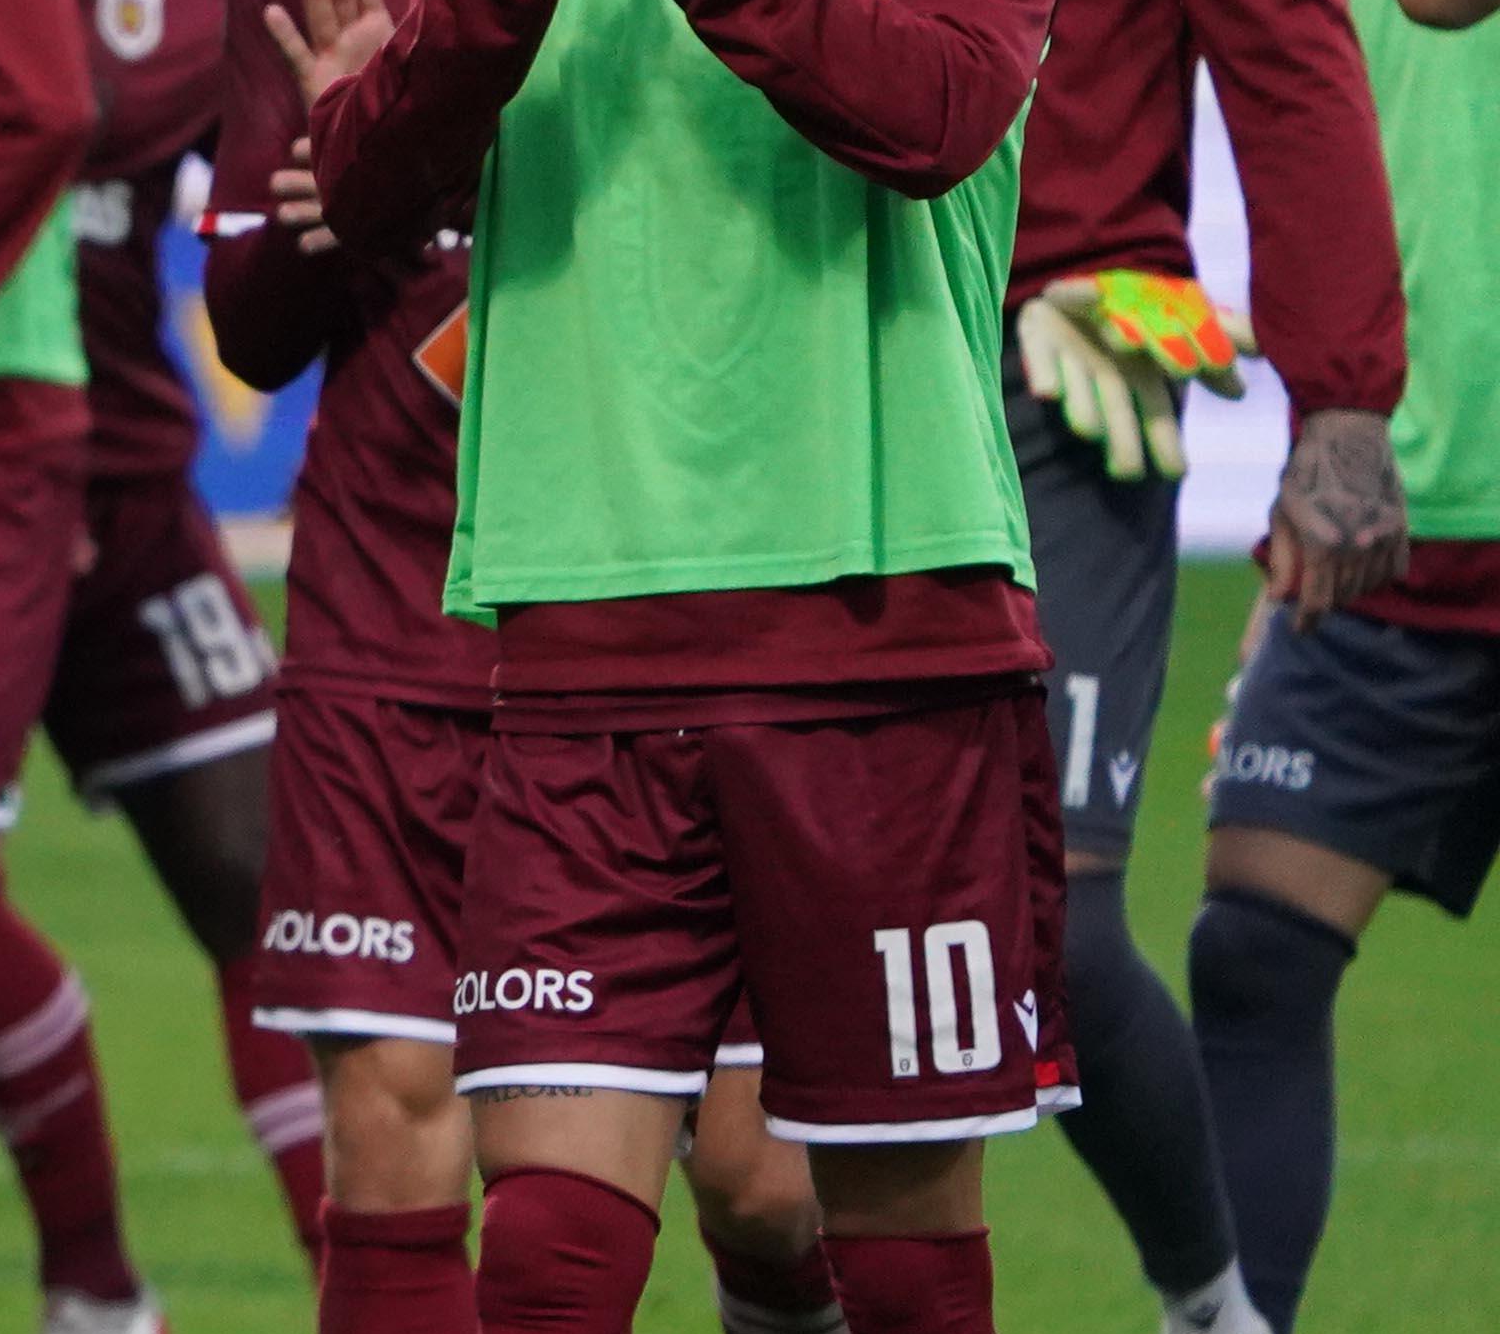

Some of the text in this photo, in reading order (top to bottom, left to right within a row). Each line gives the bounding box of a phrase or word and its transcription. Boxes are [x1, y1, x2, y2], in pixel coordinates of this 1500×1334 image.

[138, 573, 264, 710] 19
[1062, 675, 1100, 807] 1
[873, 919, 1002, 1078] 10
